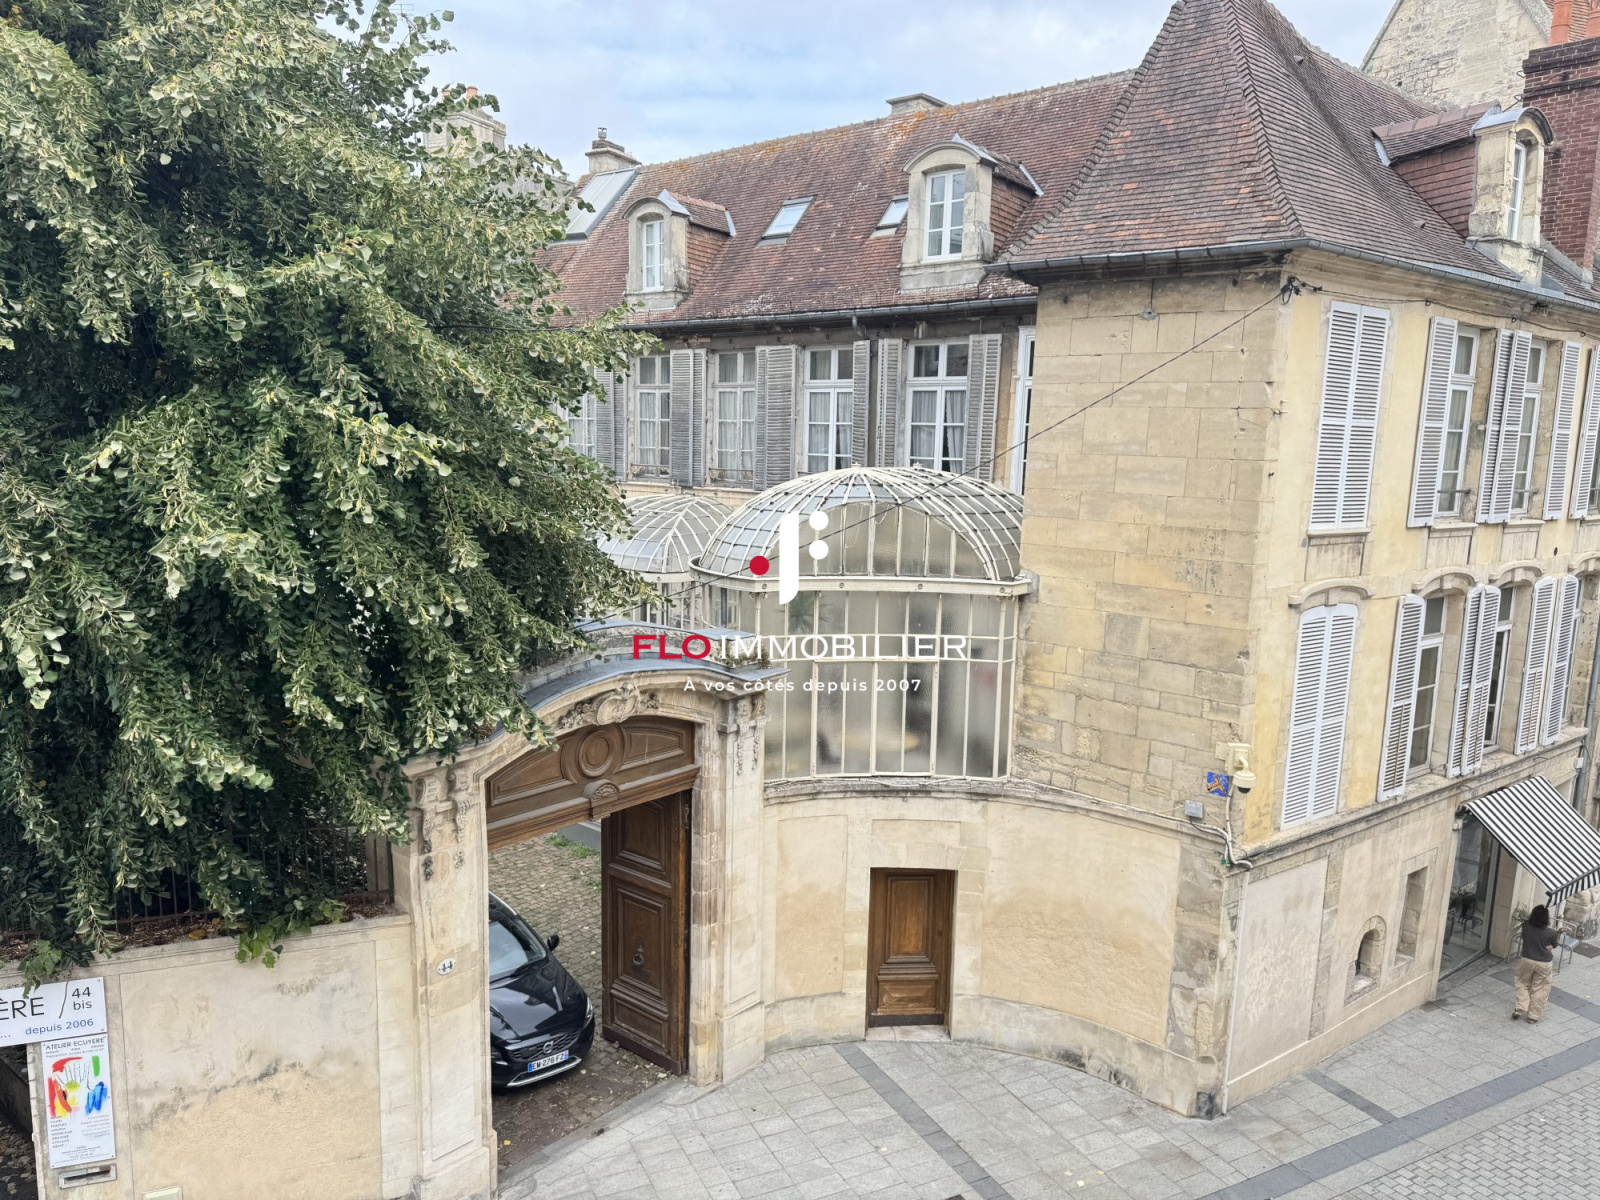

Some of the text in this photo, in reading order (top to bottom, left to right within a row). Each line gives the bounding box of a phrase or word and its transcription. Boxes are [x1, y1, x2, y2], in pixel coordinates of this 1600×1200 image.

[72, 987, 91, 998] 44
[73, 1000, 92, 1010] bis
[25, 1023, 62, 1035] depuis
[66, 1019, 93, 1030] 2006
